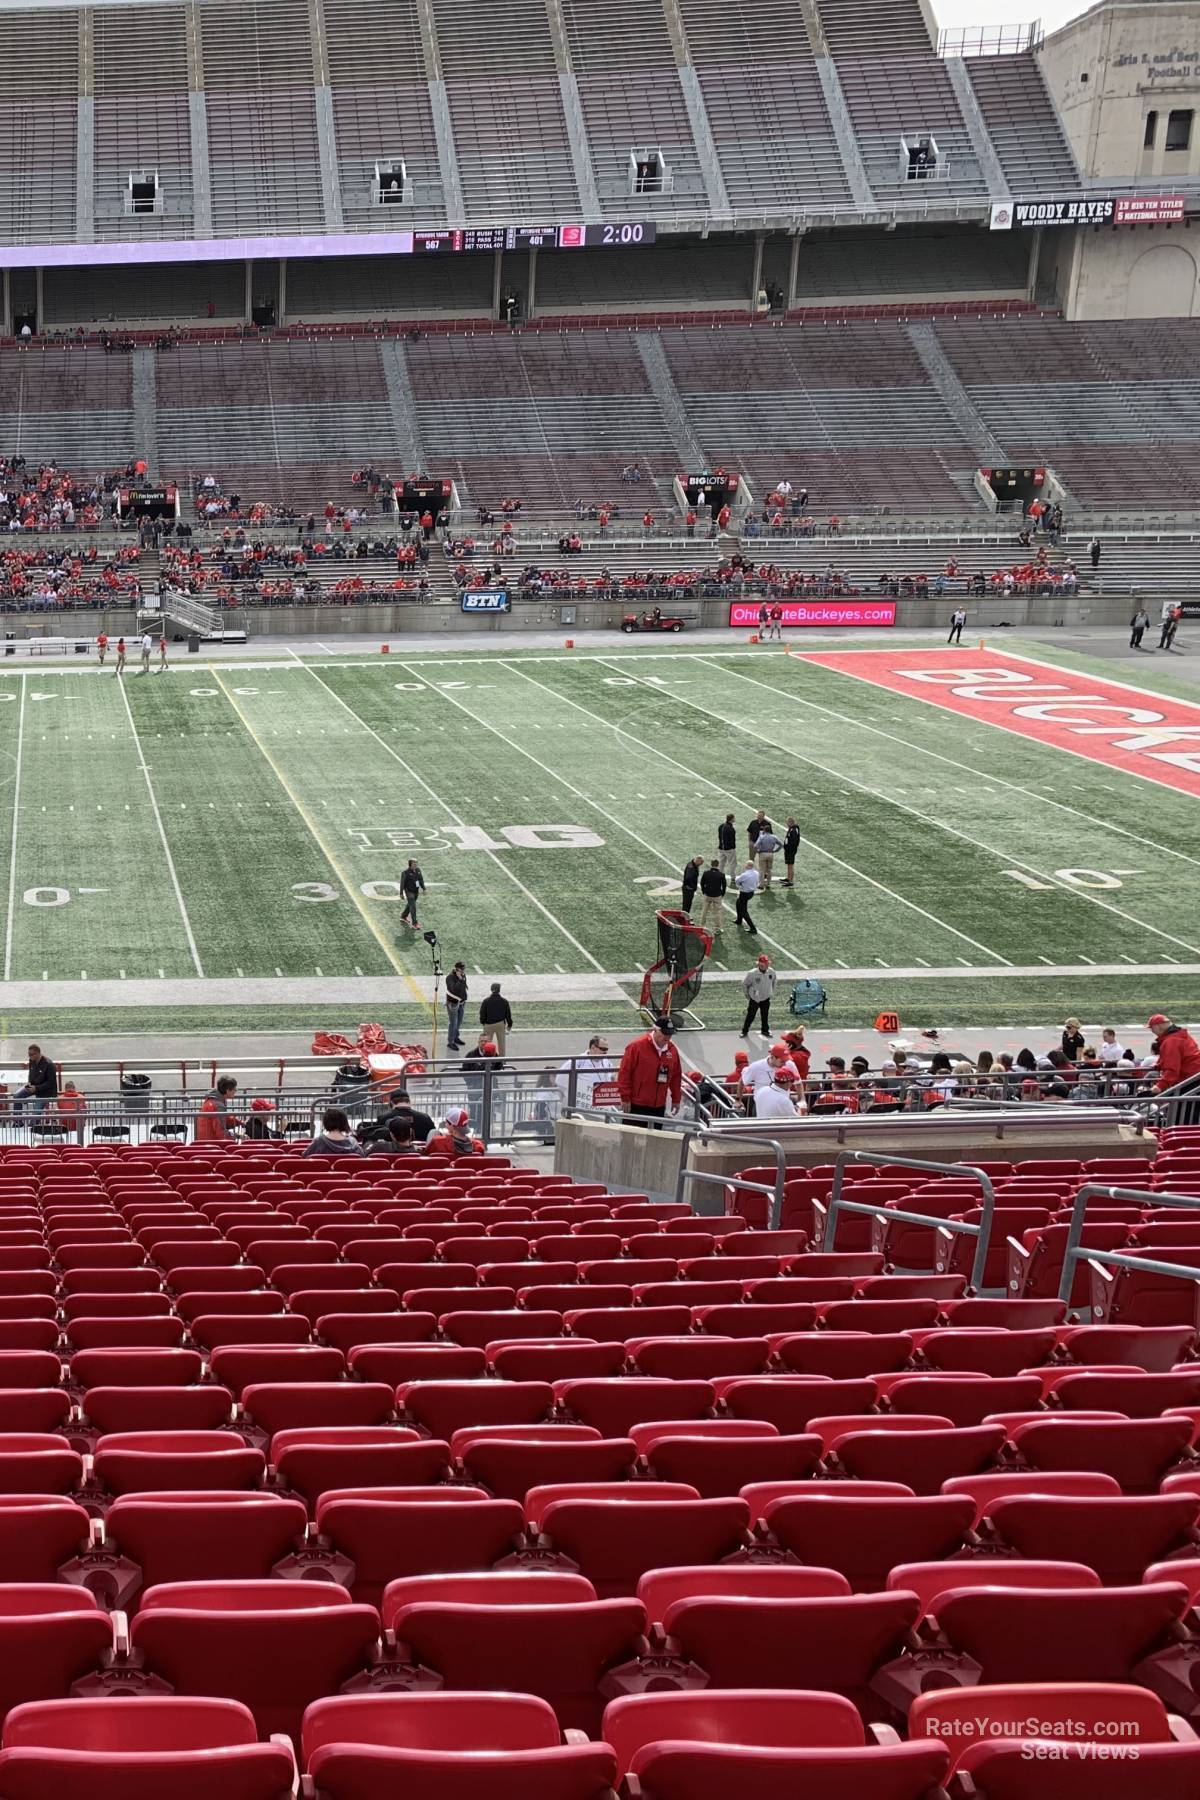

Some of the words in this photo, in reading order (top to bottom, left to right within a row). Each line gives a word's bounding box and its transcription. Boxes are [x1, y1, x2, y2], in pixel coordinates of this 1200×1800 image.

[1016, 203, 1065, 220] WOODY
[1067, 201, 1113, 218] HAYES
[529, 236, 544, 245] 401
[602, 224, 643, 243] 2:00
[466, 594, 501, 607] BTN
[189, 687, 260, 697] 30
[394, 681, 471, 690] 20
[999, 868, 1123, 890] 10
[291, 880, 403, 902] 30
[882, 1015, 898, 1031] 20
